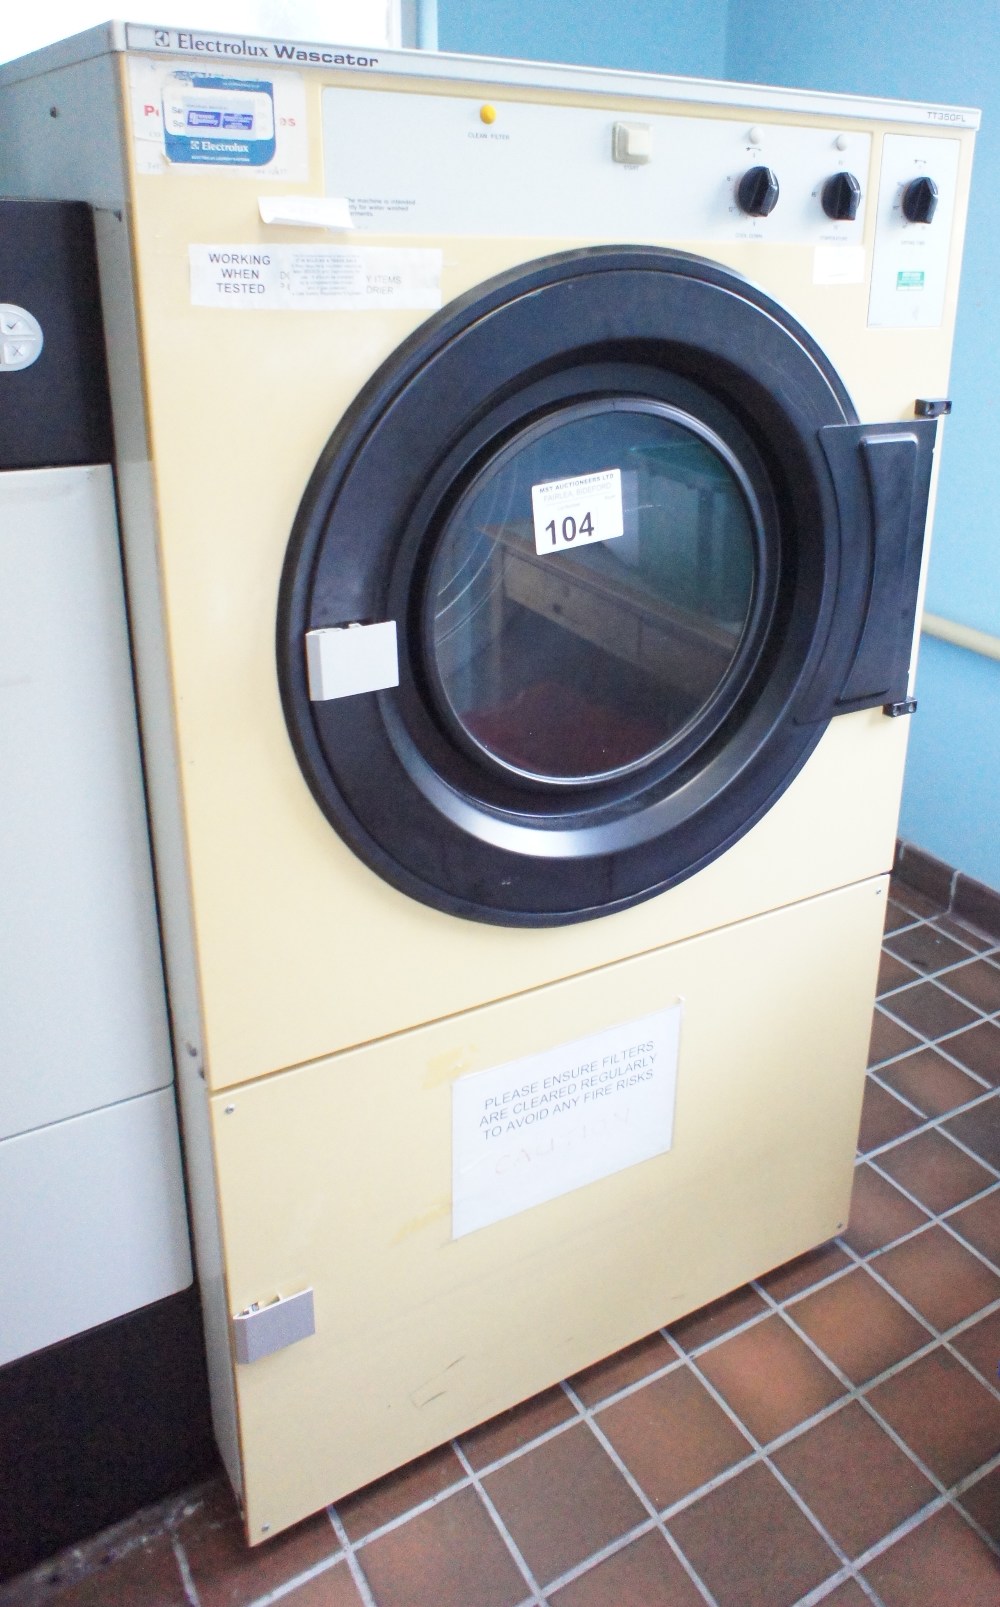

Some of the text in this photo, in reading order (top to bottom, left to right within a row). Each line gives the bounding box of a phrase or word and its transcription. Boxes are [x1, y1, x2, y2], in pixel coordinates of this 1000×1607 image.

[177, 33, 379, 68] Electrolux Wascator
[201, 141, 249, 153] Electrolux
[208, 253, 271, 266] WORKING
[221, 268, 260, 280] WHEN
[374, 275, 402, 285] ITEMS
[216, 282, 266, 294] TESTED
[366, 285, 394, 295] DRIER
[555, 476, 601, 491] AUCTIONEERS
[602, 473, 614, 481] LTD
[576, 482, 613, 495] BIDEFORD
[545, 511, 595, 546] 104
[484, 1040, 655, 1110] PLEASE ENSURE FILTERS
[479, 1053, 658, 1127] ARE CLEARED REGULARLY
[483, 1068, 654, 1141] TO AVOID ANY FIRE RISKS
